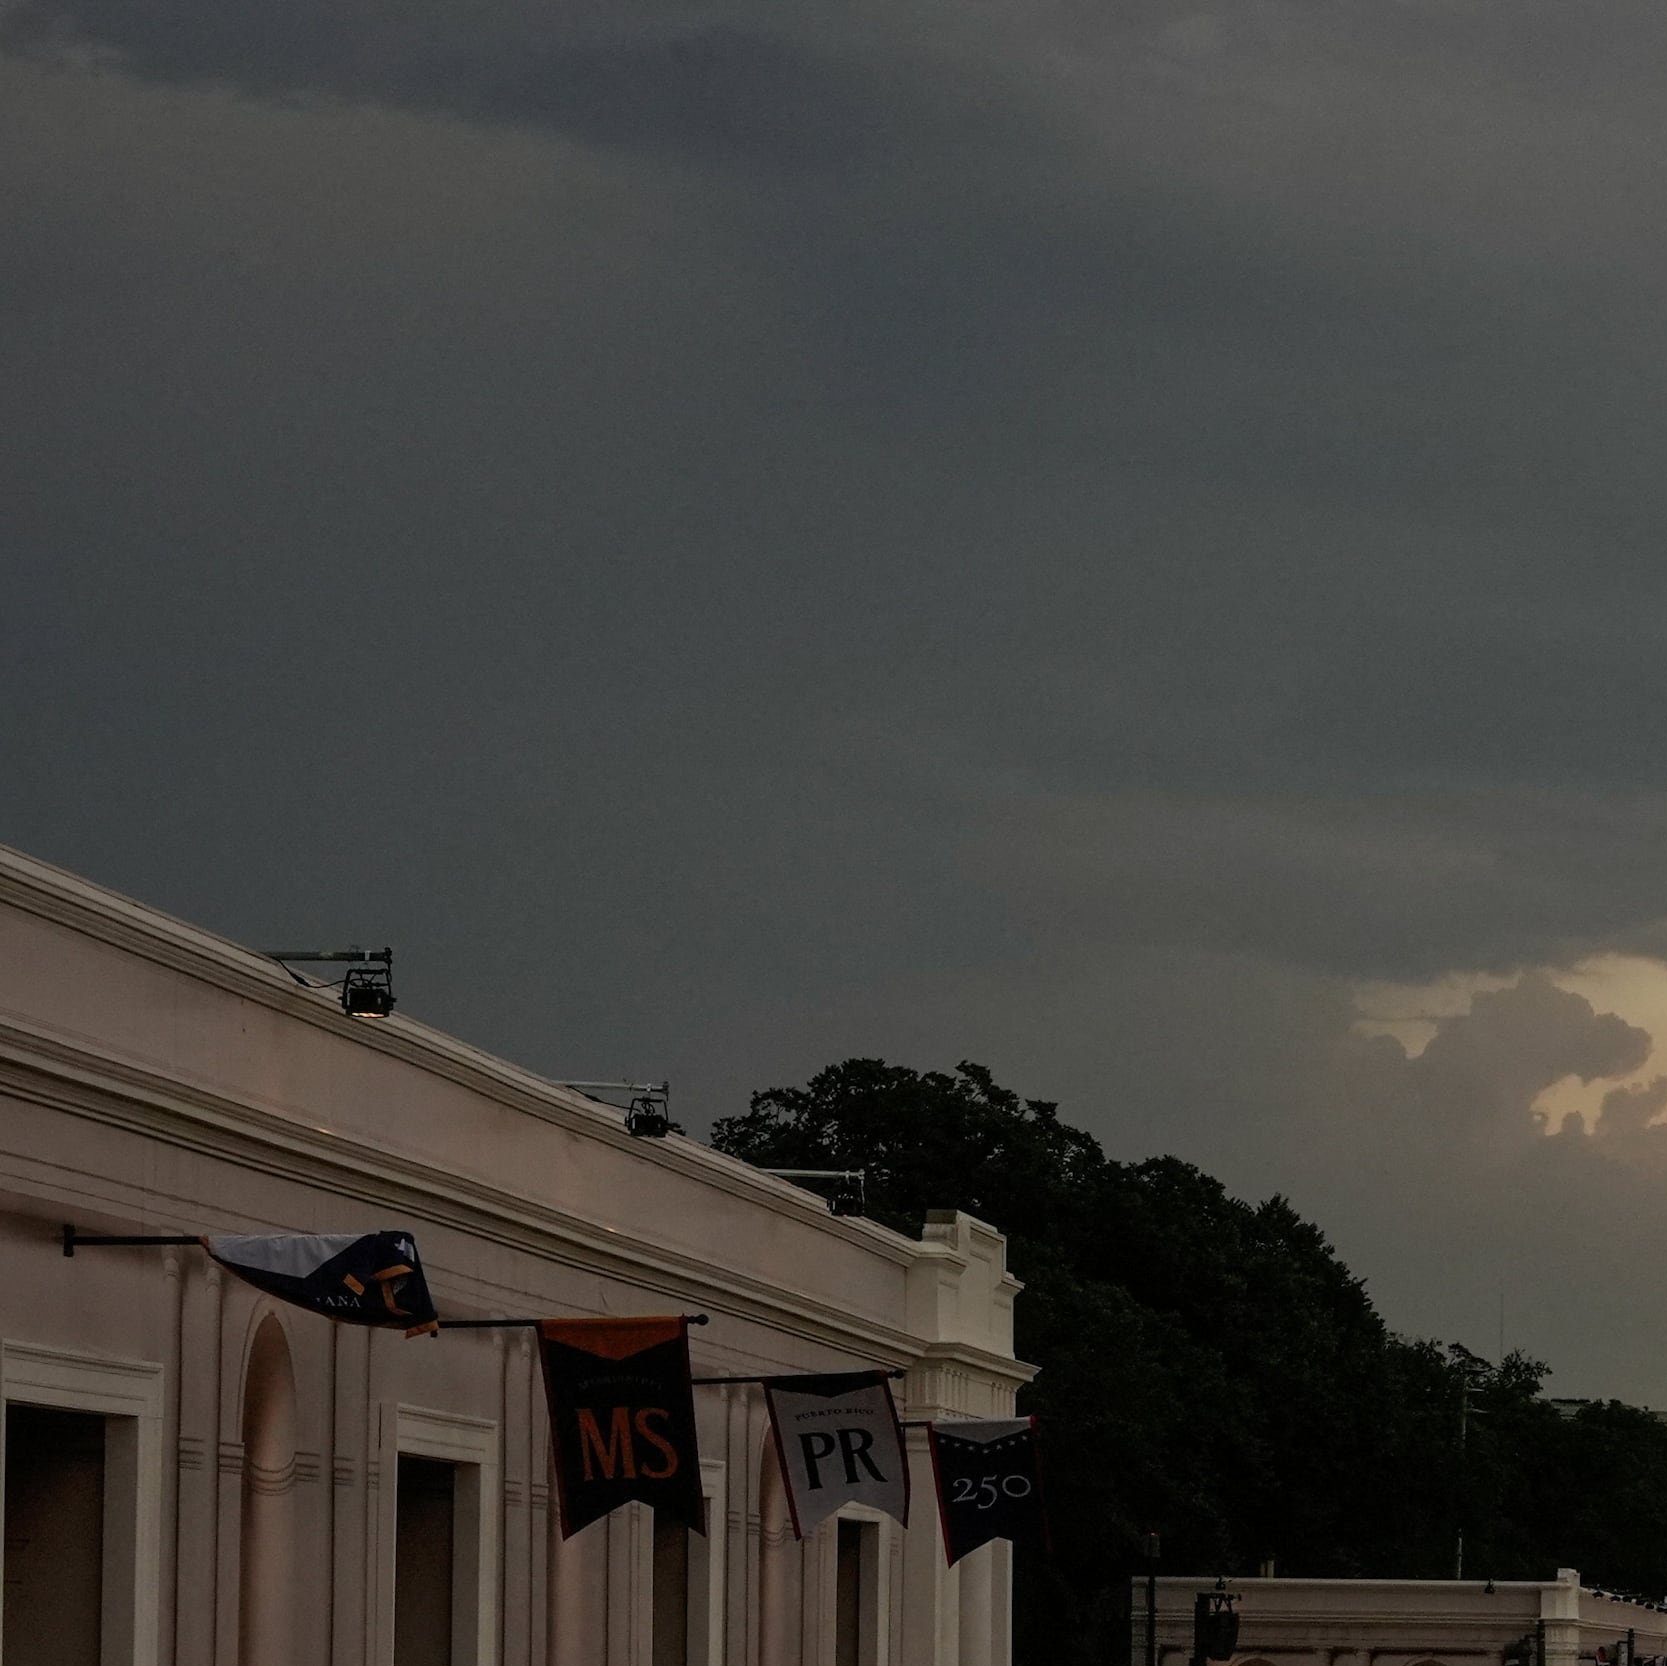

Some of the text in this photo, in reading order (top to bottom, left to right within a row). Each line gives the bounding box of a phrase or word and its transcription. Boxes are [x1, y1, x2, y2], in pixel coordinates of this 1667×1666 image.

[317, 1296, 361, 1309] ANA
[795, 1408, 842, 1421] PUERTO
[574, 1406, 680, 1482] MS
[798, 1428, 889, 1490] PR
[951, 1474, 1032, 1510] 250
